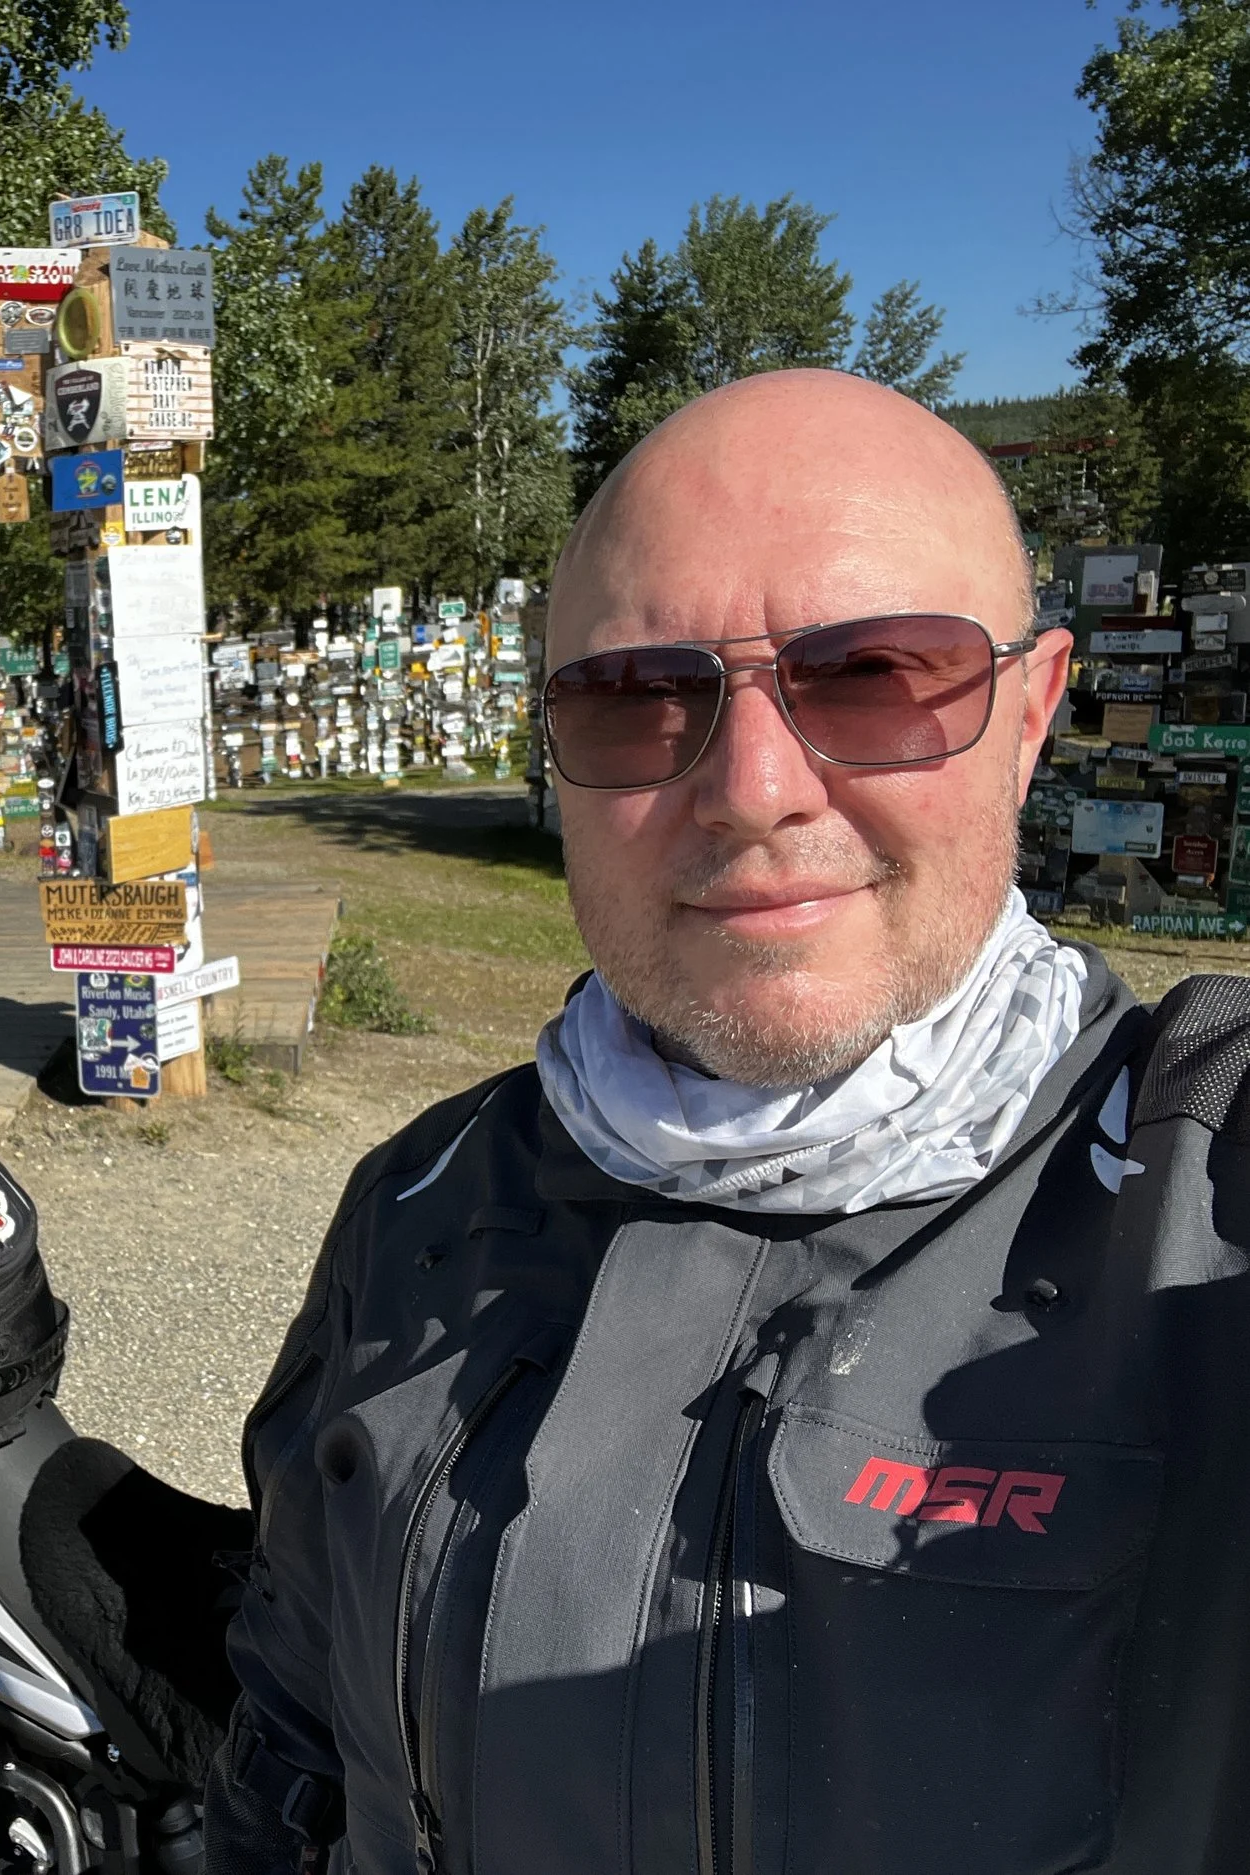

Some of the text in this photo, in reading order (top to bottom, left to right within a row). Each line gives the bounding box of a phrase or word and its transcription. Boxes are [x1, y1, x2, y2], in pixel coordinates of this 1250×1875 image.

[53, 208, 135, 242] GR8 IDEA
[1162, 731, 1196, 748] Bob
[45, 884, 180, 907] MUTERSBAUGH
[47, 907, 83, 920] MIKE
[90, 908, 132, 920] DIANNE
[1132, 914, 1226, 933] RAPIDAN AVE
[81, 986, 152, 1001] Riverton Music
[88, 1004, 147, 1020] Sandy, Utah
[95, 1065, 117, 1079] 1991
[843, 1456, 1067, 1535] MSR
